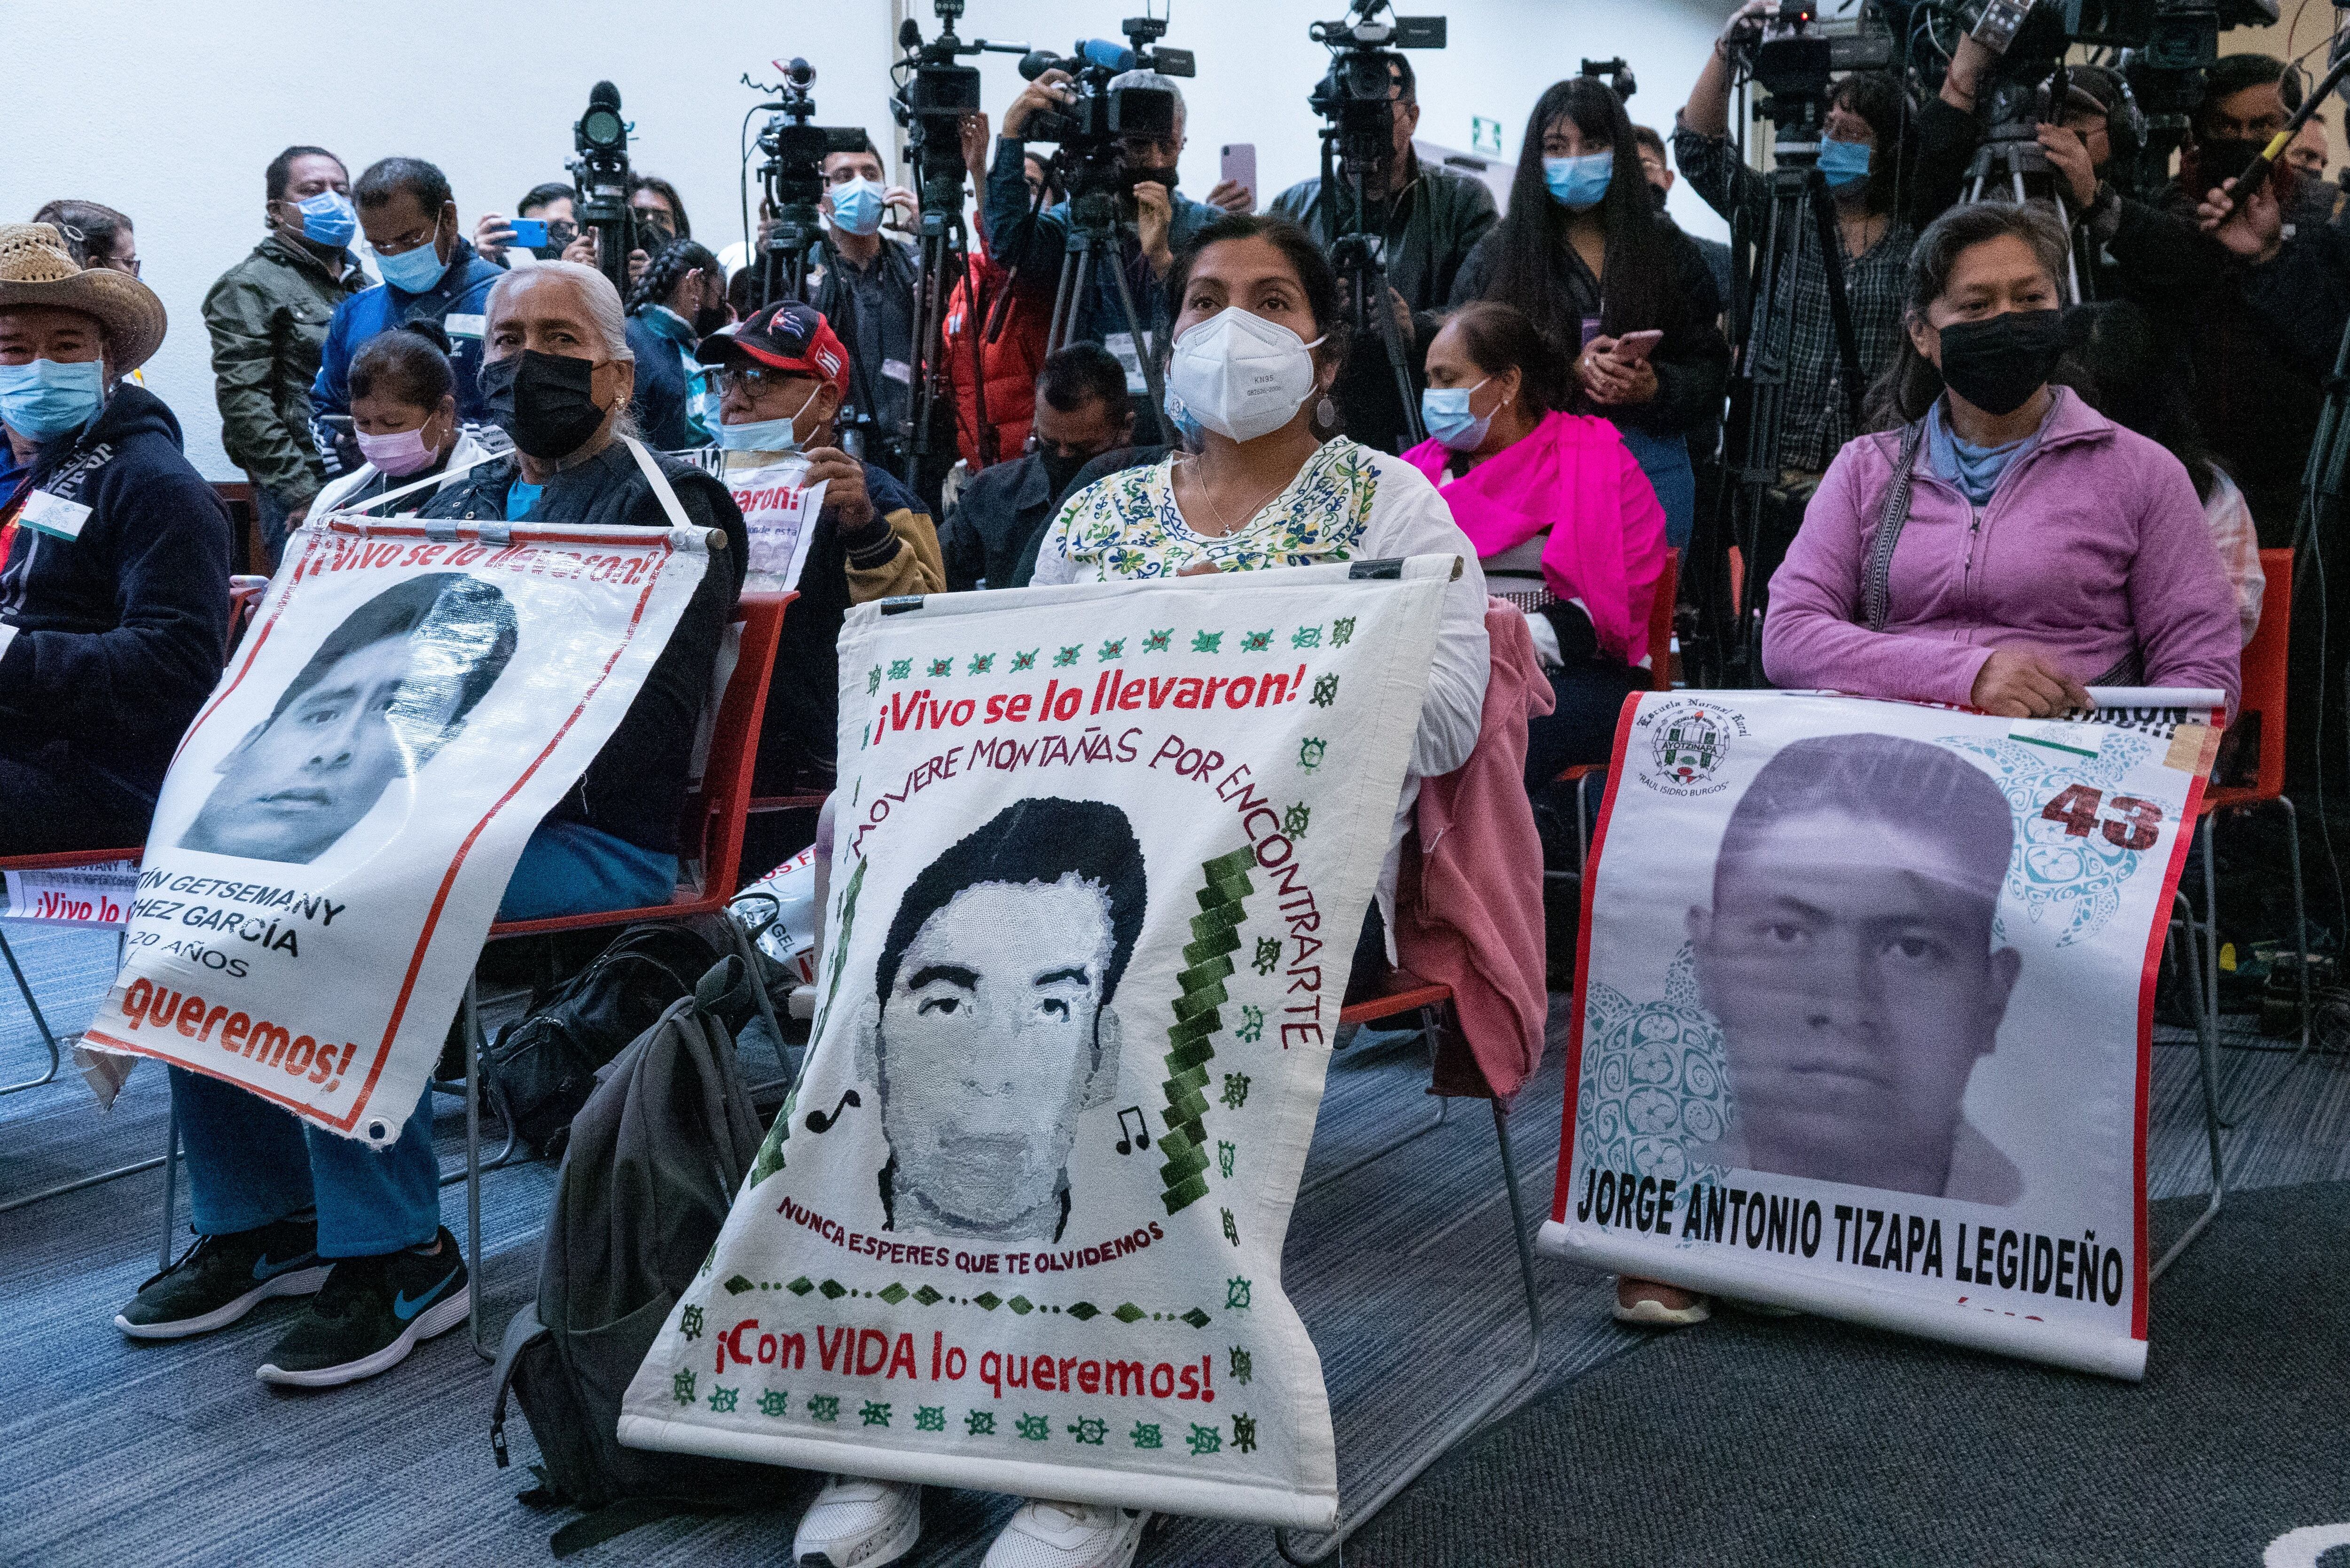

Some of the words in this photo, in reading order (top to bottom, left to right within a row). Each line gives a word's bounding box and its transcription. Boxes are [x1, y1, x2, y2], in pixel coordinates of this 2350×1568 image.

[1254, 374, 1274, 384] KN95
[1169, 401, 1181, 414] 43
[308, 538, 404, 576] ¡Vivo
[400, 544, 446, 567] se
[443, 543, 488, 566] lo
[484, 543, 660, 586] llevaron!
[873, 686, 974, 745] ¡Vivo
[982, 691, 1032, 724] se
[1037, 679, 1082, 722] lo
[1090, 663, 1307, 716] llevaron!
[1661, 741, 1718, 755] AYOTZINAPA
[1660, 785, 1688, 797] ISIDRO
[2041, 783, 2163, 850] 43
[34, 891, 93, 921] ¡Vivo
[98, 895, 119, 922] lo
[169, 875, 345, 926] GETSEMANY
[852, 746, 964, 860] MOVERE
[966, 726, 1143, 772] MONTAÑAS
[1149, 734, 1224, 783] POR
[1216, 764, 1324, 1050] ENCONTRARTE
[129, 931, 161, 946] 20
[161, 940, 250, 978] AÑOS
[182, 905, 299, 958] GARCÍA
[121, 977, 357, 1093] queremos!
[776, 1195, 845, 1248] NUNCA
[848, 1233, 949, 1268] ESPERES
[955, 1251, 999, 1273] QUE
[1004, 1252, 1031, 1275] TE
[1034, 1221, 1164, 1273] OLVIDEMOS
[1577, 1167, 1677, 1235] JORGE
[1684, 1184, 1822, 1258] ANTONIO
[1834, 1204, 1943, 1278] TIZAPA
[1955, 1223, 2123, 1306] LEGIDEÑO
[714, 1318, 806, 1375] ¡Con
[816, 1325, 917, 1380] VIDA
[931, 1330, 967, 1381] lo
[979, 1349, 1215, 1404] queremos!
